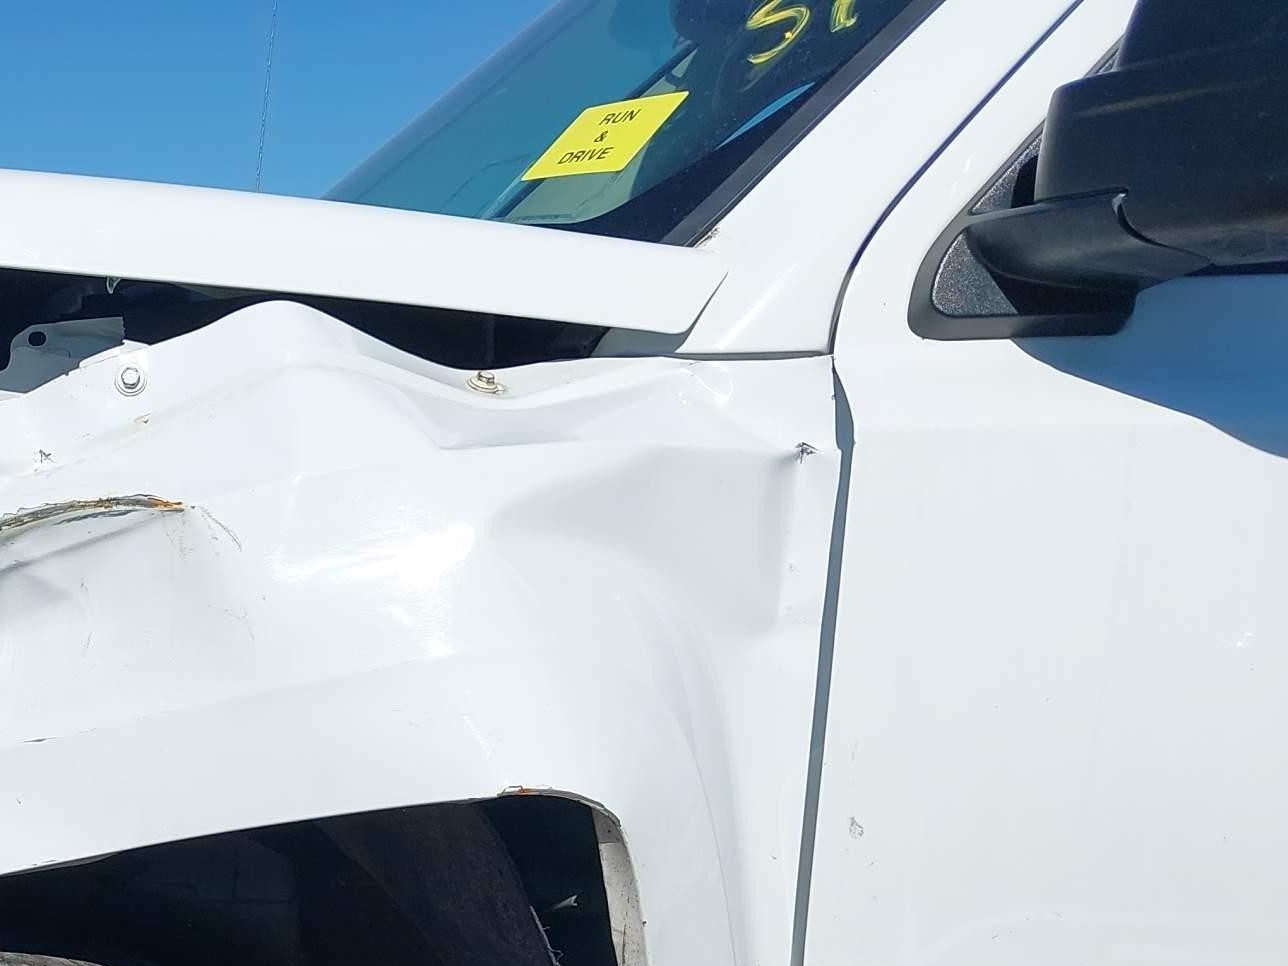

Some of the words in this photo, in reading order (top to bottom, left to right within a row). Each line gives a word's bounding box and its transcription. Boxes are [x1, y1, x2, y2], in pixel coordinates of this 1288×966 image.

[599, 109, 642, 126] RUN
[593, 130, 609, 143] &
[557, 146, 615, 165] DRIVE
